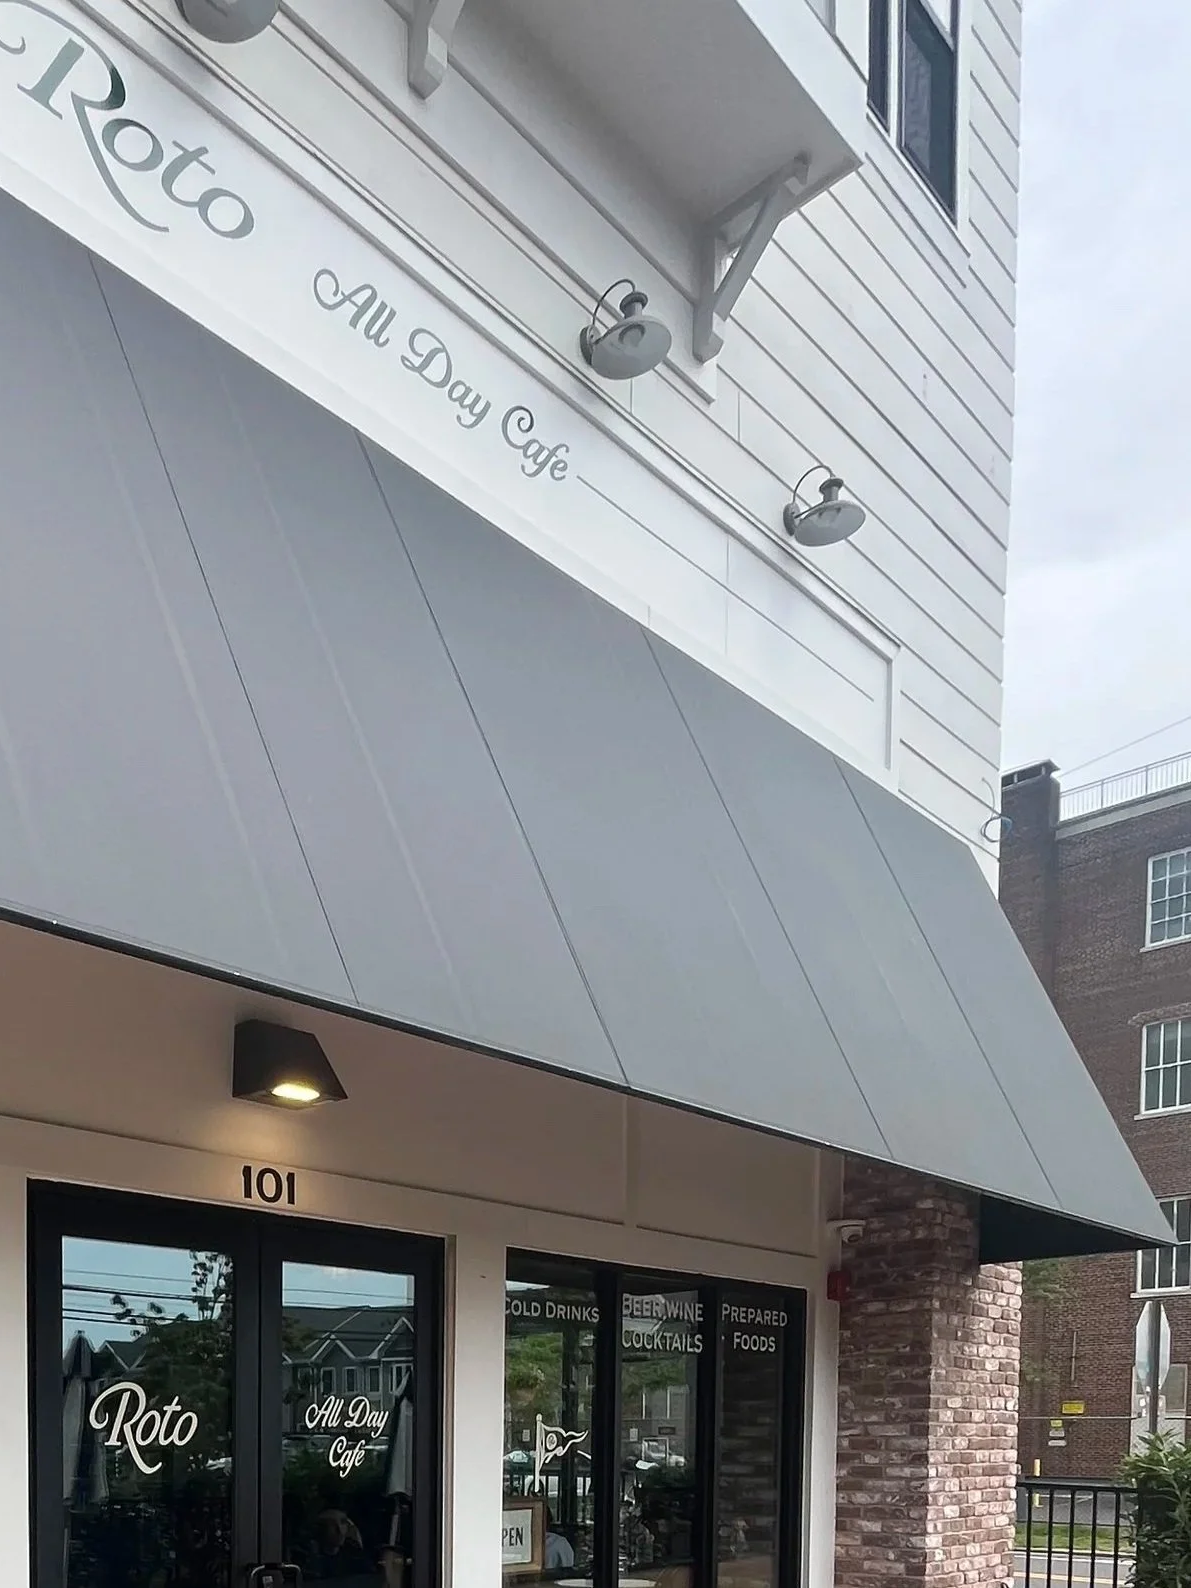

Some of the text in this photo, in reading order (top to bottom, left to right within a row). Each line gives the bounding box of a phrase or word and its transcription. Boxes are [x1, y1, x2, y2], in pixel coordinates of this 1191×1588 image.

[313, 268, 570, 481] All Day Cafe
[241, 1164, 296, 1206] 101
[545, 1301, 600, 1323] DRINKS
[721, 1303, 788, 1327] PREPARED
[622, 1329, 703, 1354] COCKTAILS
[733, 1331, 776, 1352] FOODS
[89, 1382, 199, 1474] Roto
[305, 1395, 389, 1438] All Day
